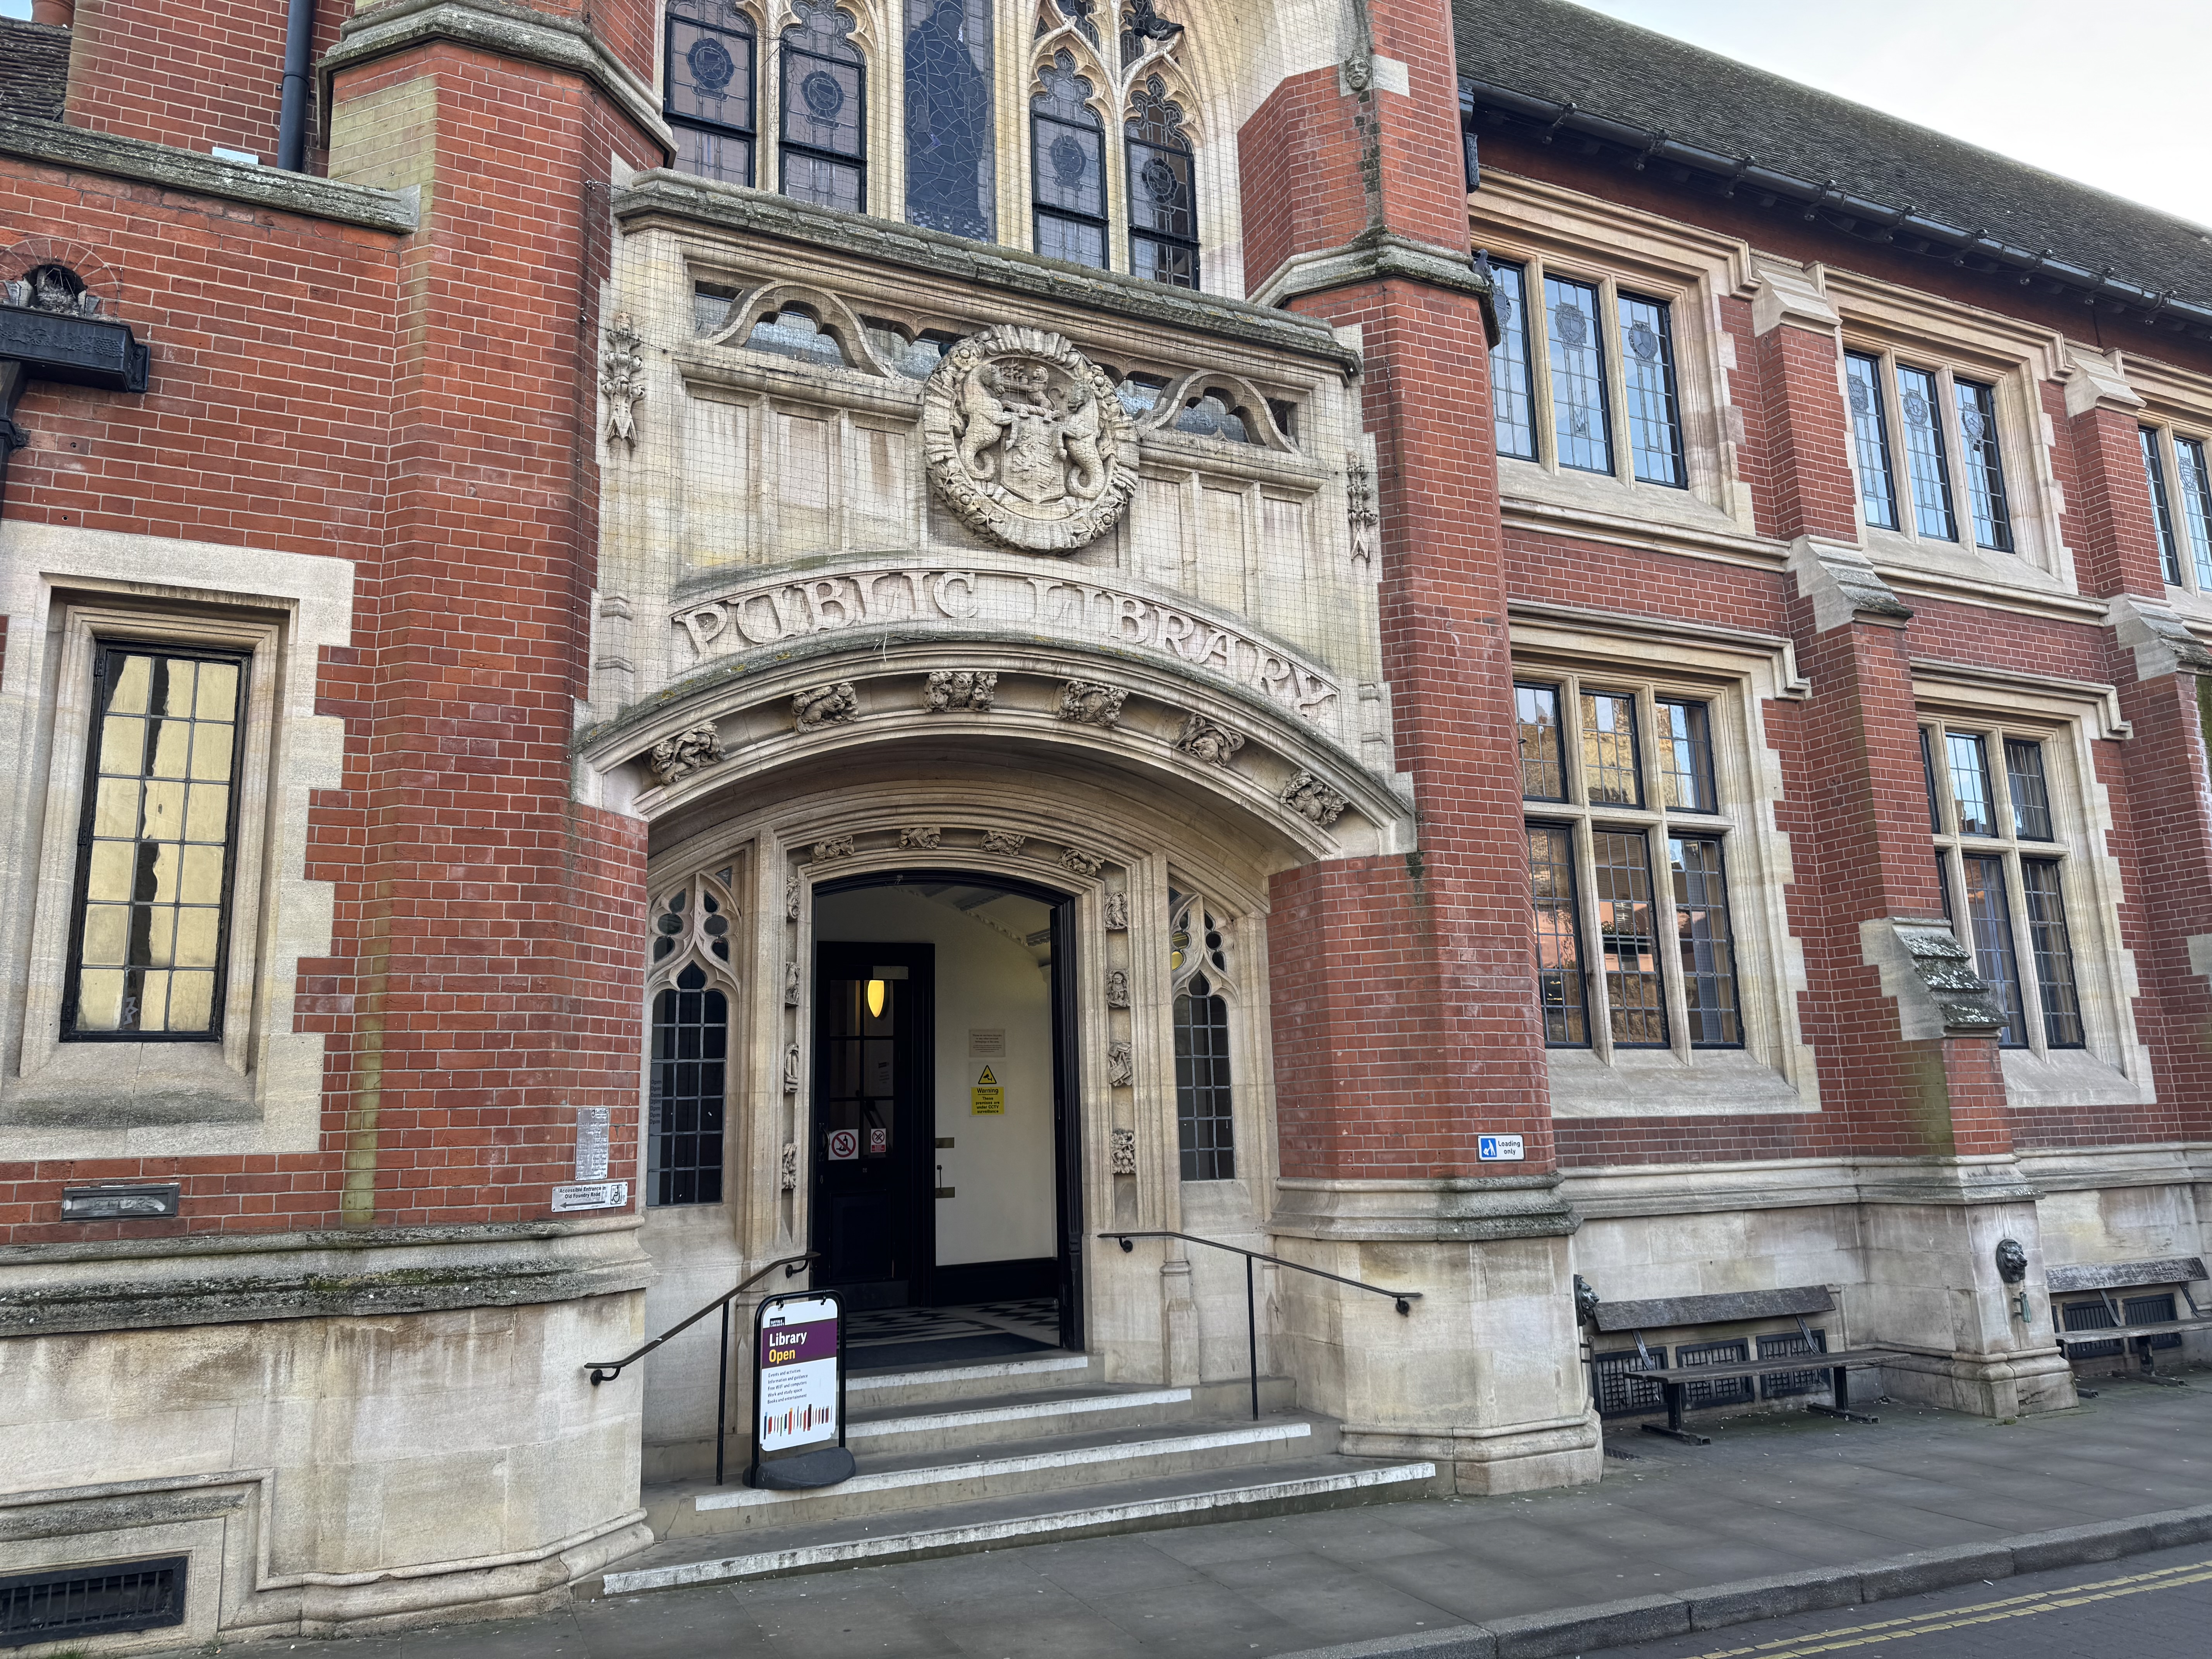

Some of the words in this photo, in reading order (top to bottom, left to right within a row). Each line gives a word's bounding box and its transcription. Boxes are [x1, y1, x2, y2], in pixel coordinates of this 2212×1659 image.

[672, 571, 979, 661] PUBLIC
[1025, 577, 1338, 718] LIBRARY
[769, 1332, 807, 1347] Library
[769, 1349, 795, 1364] Open
